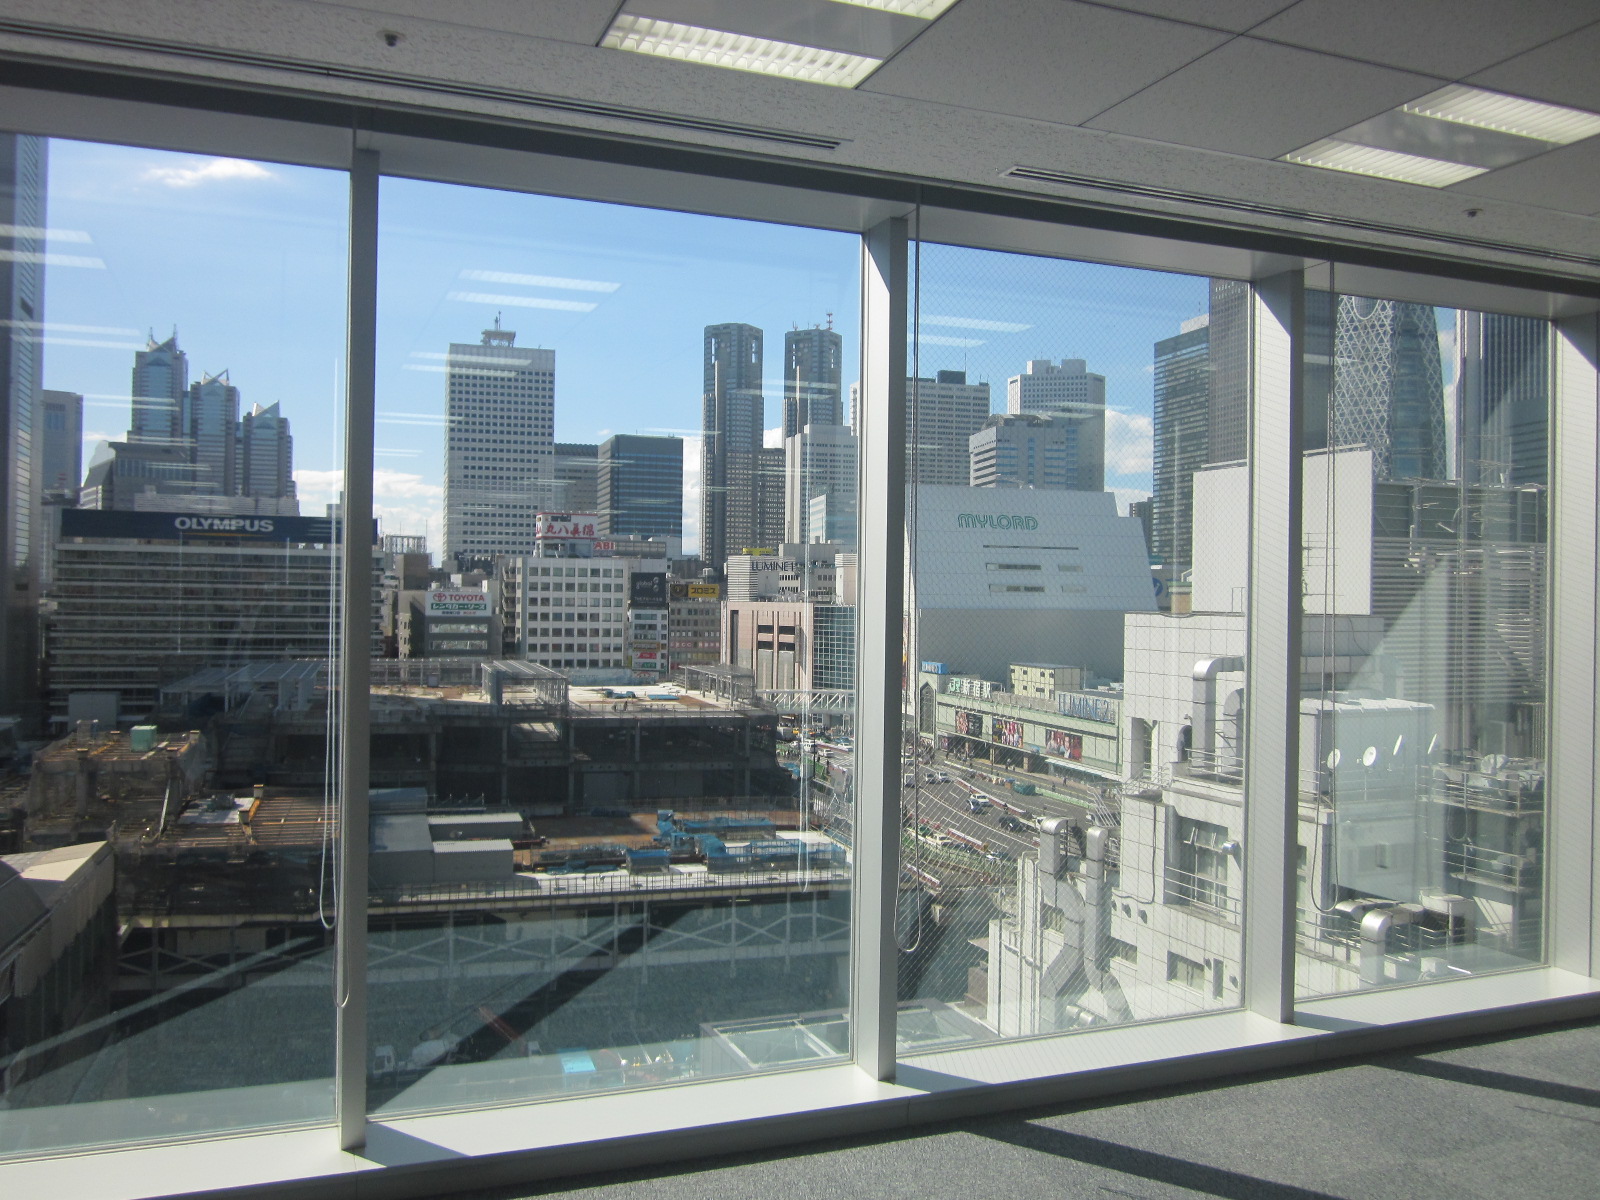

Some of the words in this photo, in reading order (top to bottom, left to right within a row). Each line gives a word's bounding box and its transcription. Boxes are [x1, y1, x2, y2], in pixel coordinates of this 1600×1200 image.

[174, 517, 274, 532] OLYMPUS
[957, 513, 1039, 531] MYLORD
[691, 587, 716, 595] プロミス
[448, 594, 485, 602] TOYOTA
